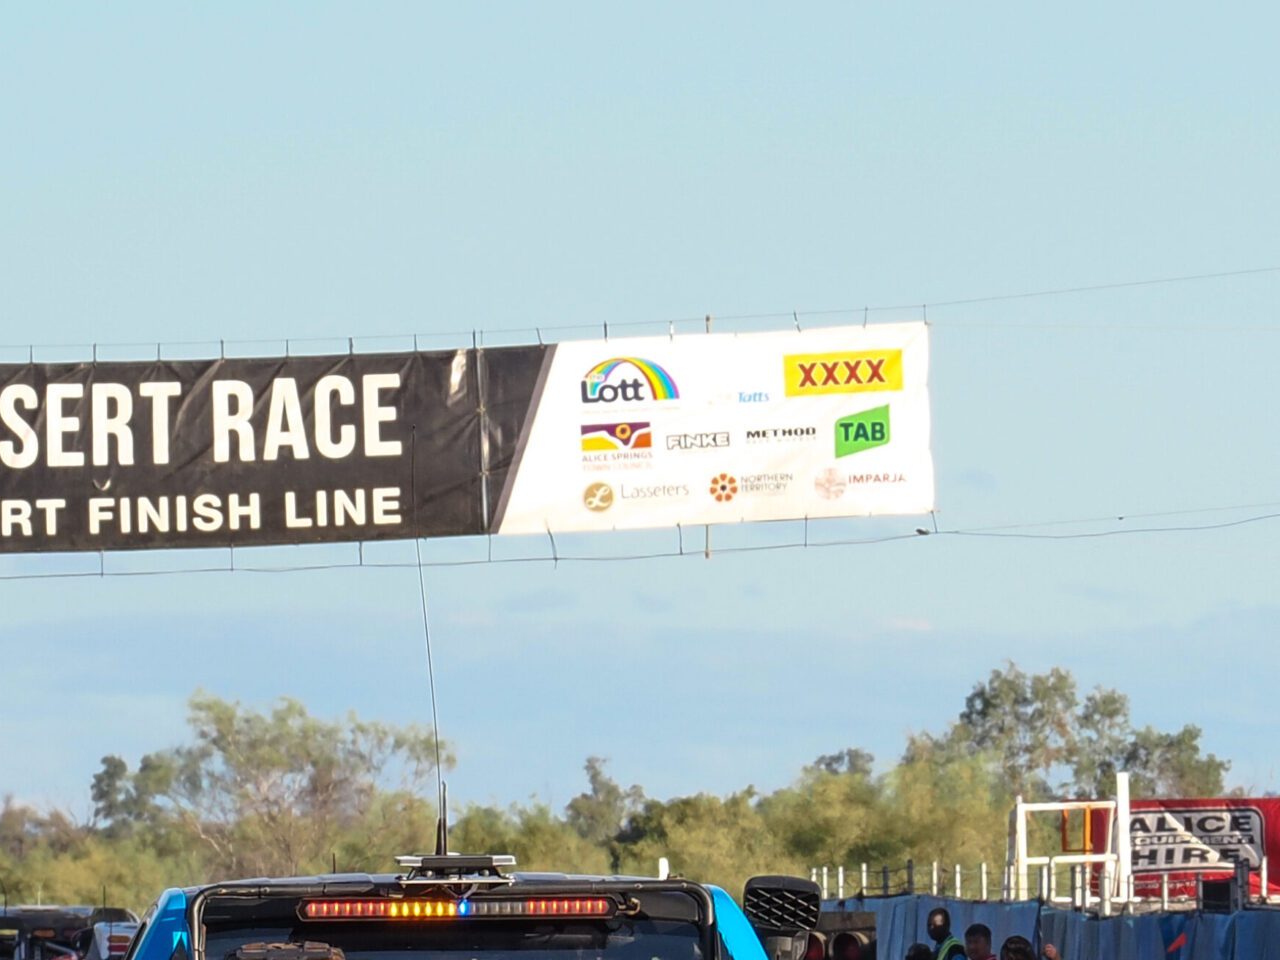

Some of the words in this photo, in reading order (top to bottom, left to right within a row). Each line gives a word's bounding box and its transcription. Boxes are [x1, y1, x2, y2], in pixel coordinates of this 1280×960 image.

[798, 359, 886, 388] XXXX
[581, 378, 646, 404] Lott
[212, 372, 403, 463] RACE
[666, 431, 730, 450] FINKE
[746, 427, 816, 440] METHOD
[839, 421, 886, 443] TAB
[582, 453, 608, 463] ALICE
[611, 451, 653, 461] SPRINGS
[740, 473, 793, 484] NORTHERN
[740, 482, 787, 493] TERRITORY
[848, 473, 907, 485] IMPARJA
[621, 484, 690, 499] Lasseters
[88, 492, 261, 535] FINISH
[284, 486, 403, 529] LINE
[1130, 814, 1253, 834] ALICE
[1130, 835, 1255, 846] QUIPMENT
[1131, 847, 1241, 866] HIRE
